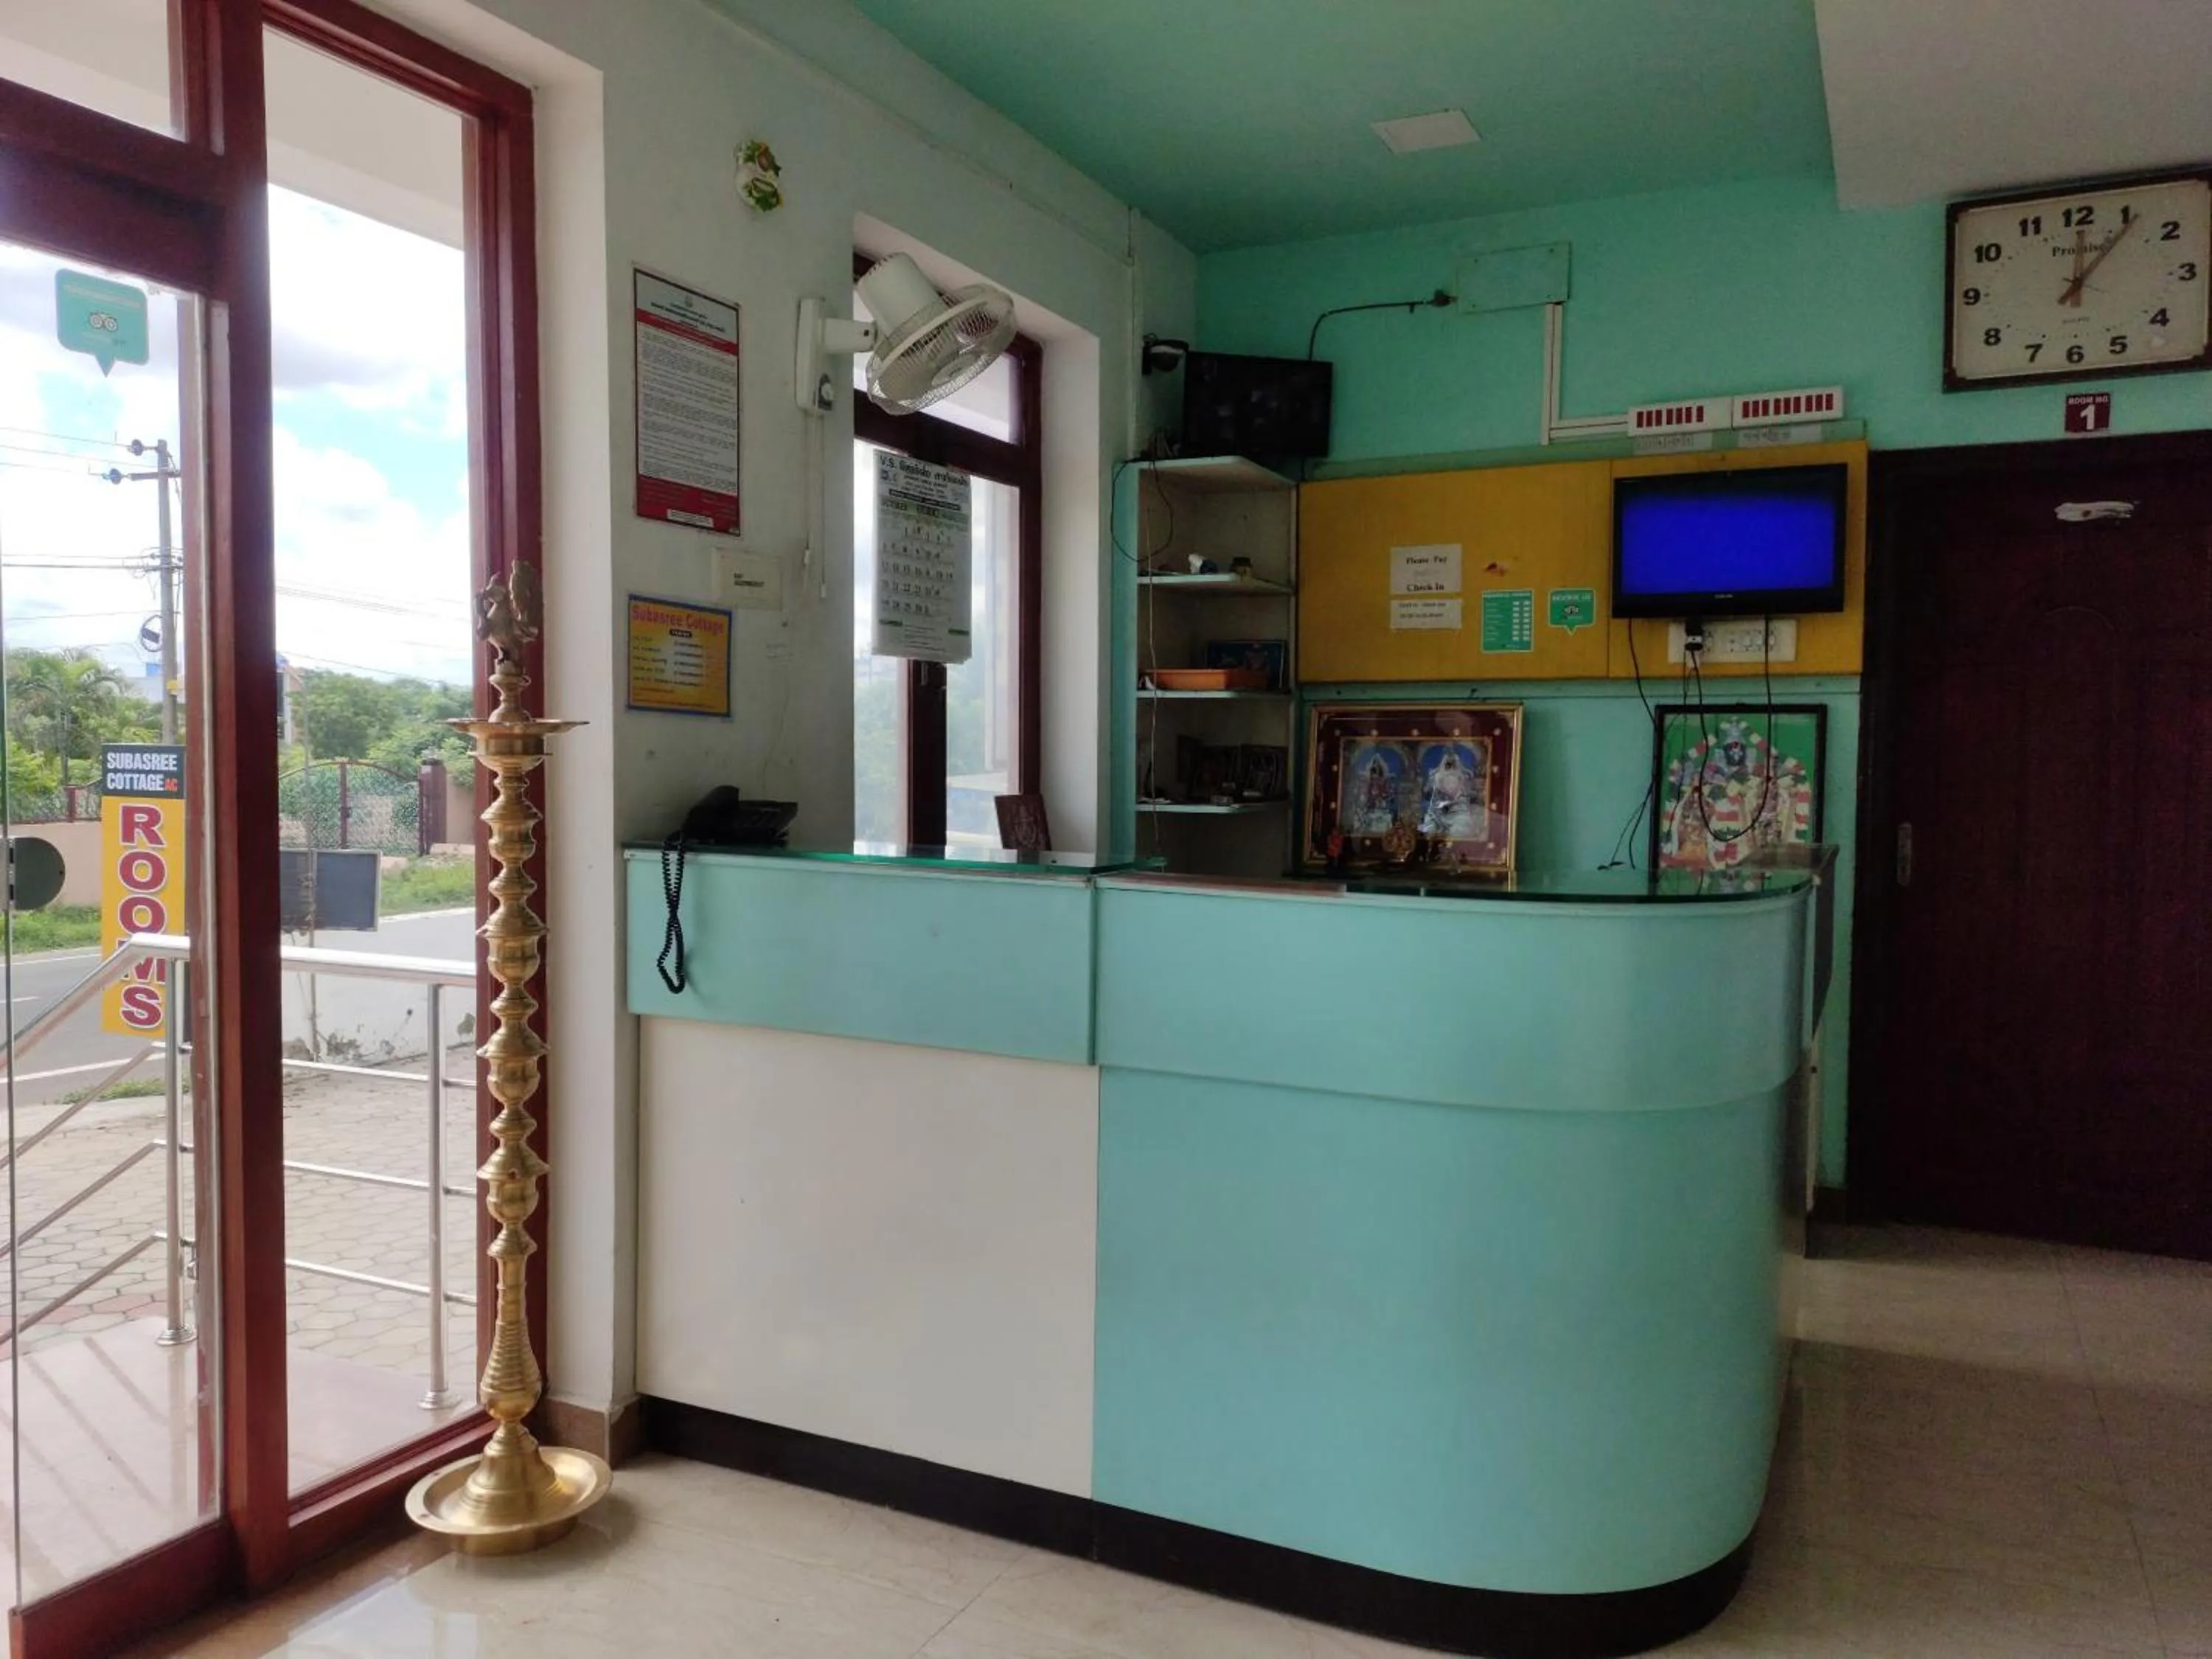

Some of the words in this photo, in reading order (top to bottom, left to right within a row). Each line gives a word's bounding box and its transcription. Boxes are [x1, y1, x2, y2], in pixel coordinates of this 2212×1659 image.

[2062, 205, 2094, 228] 12
[2120, 205, 2130, 225] 1
[2019, 216, 2042, 237] 11
[2160, 220, 2181, 241] 2
[1975, 243, 2002, 263] 10
[2052, 243, 2106, 257] Prois
[2178, 262, 2197, 282] 3
[1962, 287, 1981, 306] 9
[2149, 307, 2170, 327] 4
[1983, 327, 2002, 347] 8
[2109, 335, 2128, 355] 5
[2025, 343, 2043, 363] 7
[2066, 345, 2084, 364] 6
[2080, 404, 2096, 430] 1
[107, 752, 178, 771] SUBASREE
[107, 772, 164, 791] COTTAGE
[164, 778, 178, 792] AC
